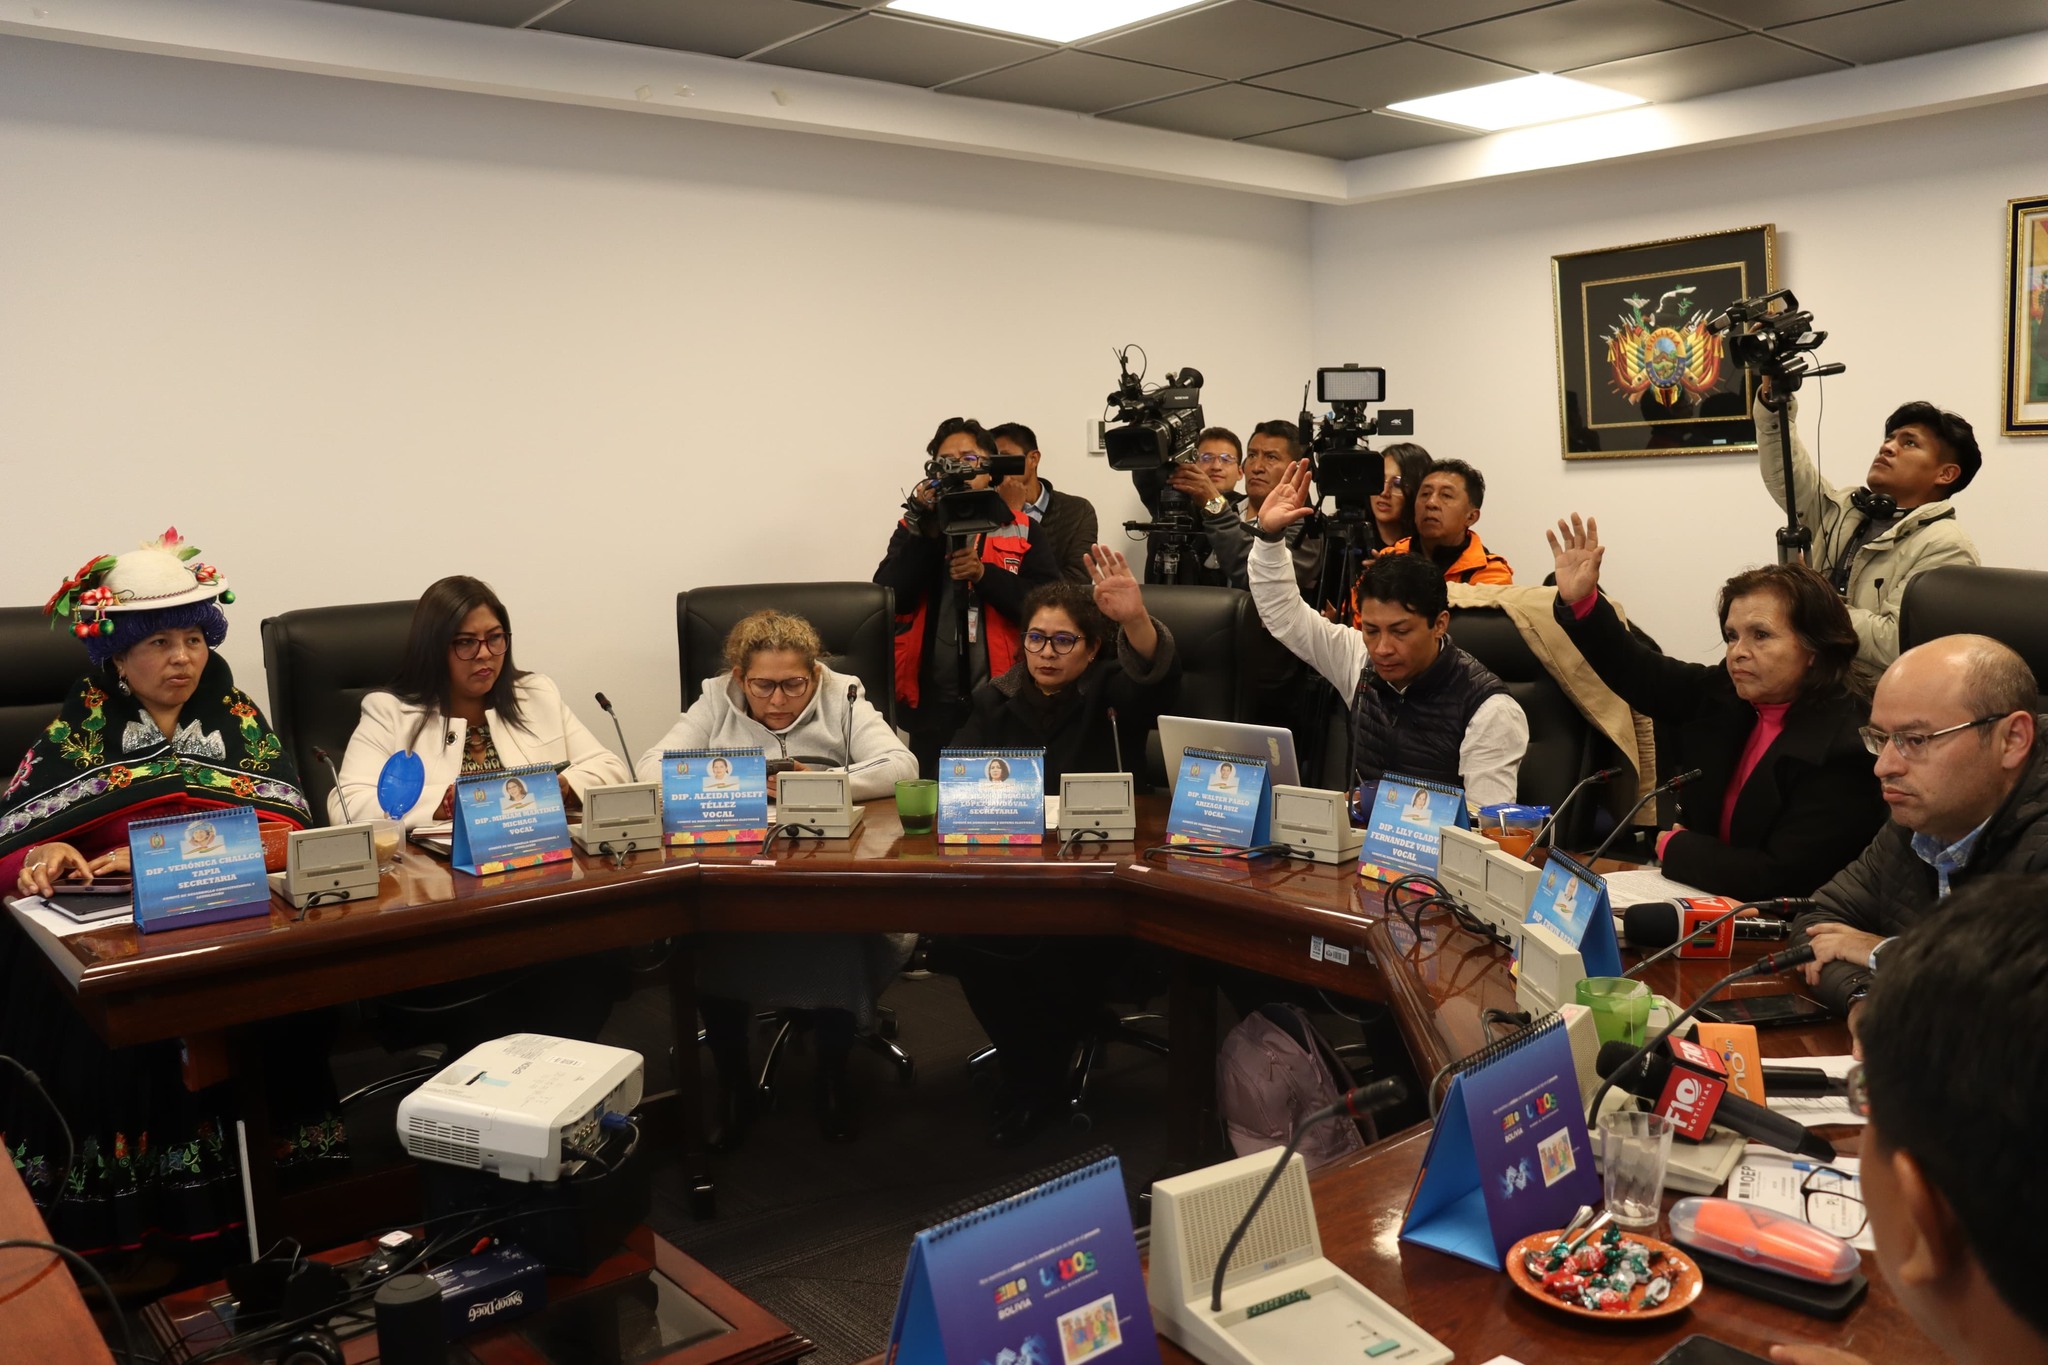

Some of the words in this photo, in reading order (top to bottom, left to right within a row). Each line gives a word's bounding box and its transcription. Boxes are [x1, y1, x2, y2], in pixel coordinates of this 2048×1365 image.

[671, 793, 693, 801] DIP.
[694, 791, 729, 800] ALEIDA
[700, 800, 736, 809] TÉLLEZ
[1201, 793, 1228, 803] WALTER
[474, 817, 492, 825] DIP.
[702, 810, 735, 818] VOCAL
[509, 825, 534, 835] VOCAL
[1378, 822, 1395, 833] DIP.
[1395, 826, 1414, 836] LILY
[1413, 831, 1440, 845] GLADY
[1370, 831, 1416, 849] FERNANDEZ
[1392, 848, 1417, 861] VOCAL
[146, 866, 168, 876] DIP.
[168, 857, 218, 872] VERÓNICA
[218, 851, 262, 865] CHALLCO
[178, 873, 237, 889] SECRETARIA
[191, 867, 221, 878] TAPIA
[1679, 1041, 1708, 1067] F10
[1664, 1078, 1702, 1128] F10
[1687, 1083, 1712, 1131] NOTICIAS
[1741, 1165, 1756, 1182] OEP
[495, 1291, 523, 1311] SNOOP
[997, 1297, 1033, 1320] BOLIVIA
[468, 1301, 495, 1322] DOGG
